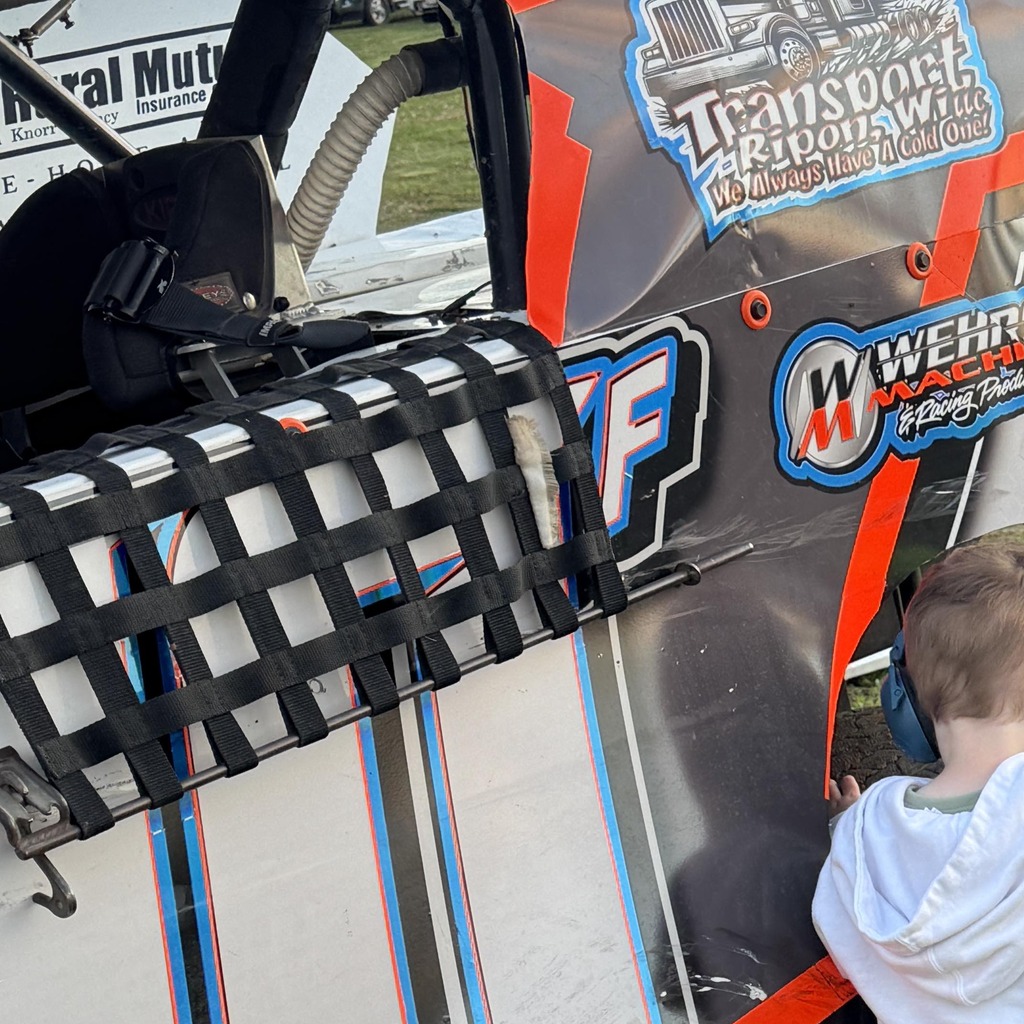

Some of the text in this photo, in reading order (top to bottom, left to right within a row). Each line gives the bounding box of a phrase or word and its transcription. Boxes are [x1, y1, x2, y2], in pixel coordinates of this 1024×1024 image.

[136, 89, 206, 115] Insurance
[673, 31, 971, 158] Transport
[713, 109, 991, 208] We Always Have A Cold One!
[738, 113, 881, 173] Ripon,
[915, 387, 979, 431] Racing
